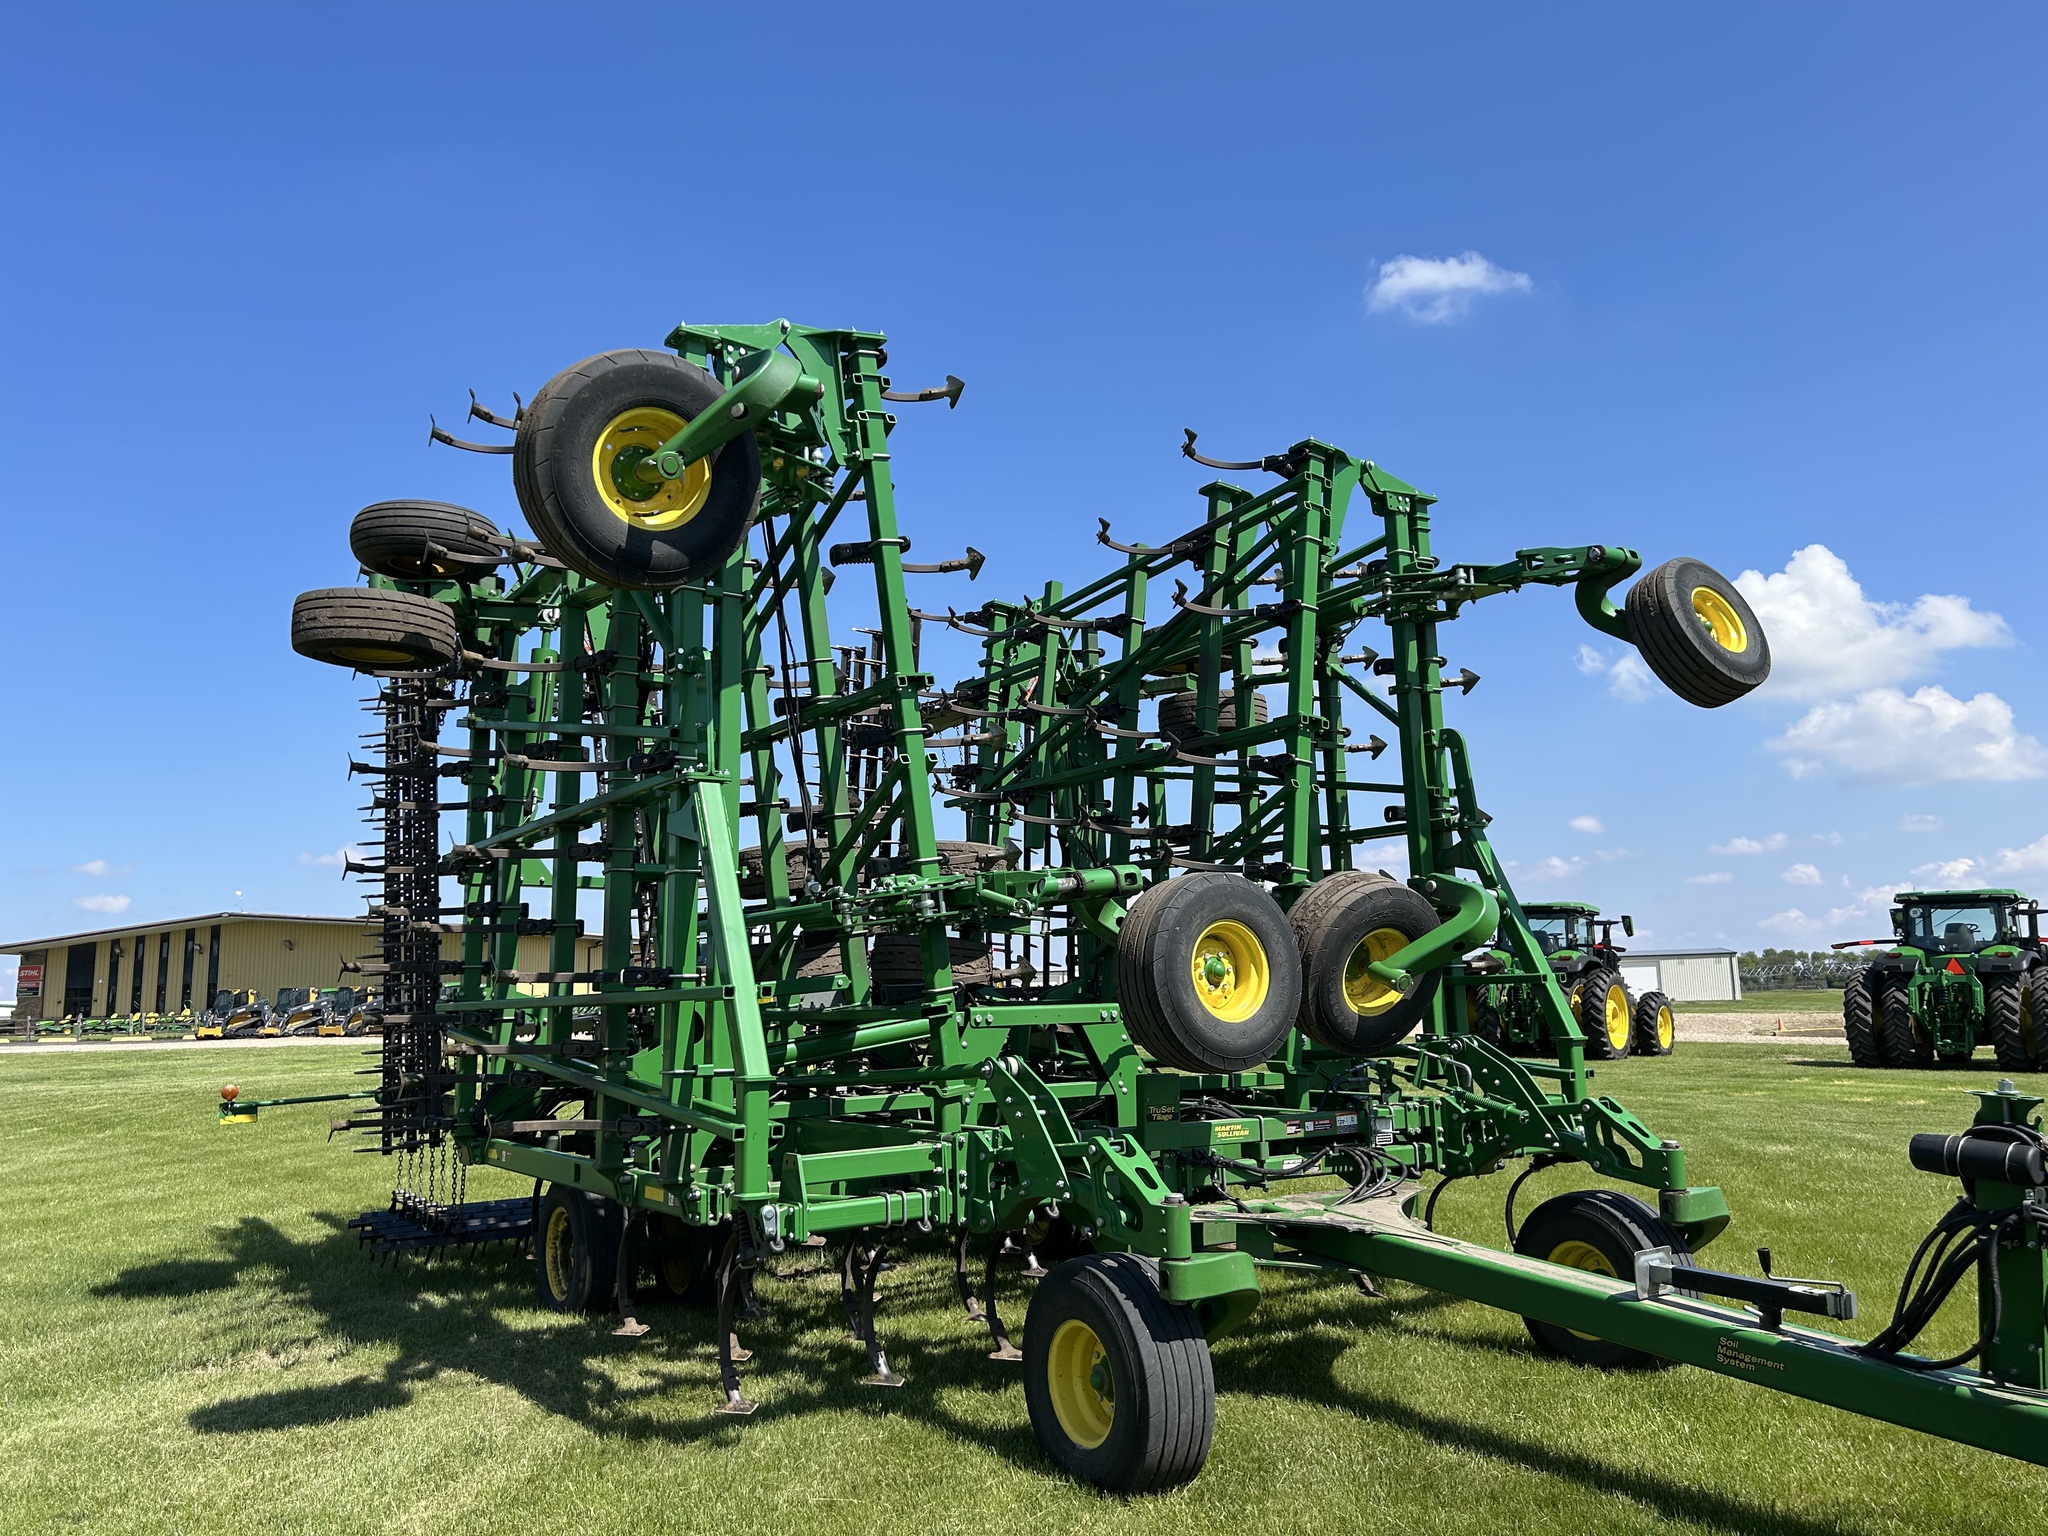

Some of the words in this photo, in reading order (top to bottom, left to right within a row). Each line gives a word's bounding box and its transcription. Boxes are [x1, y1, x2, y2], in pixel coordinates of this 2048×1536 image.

[1148, 1105, 1175, 1114] TruSet
[1151, 1113, 1173, 1121] Tillage
[1217, 1130, 1250, 1138] SULLIVAN
[1719, 1336, 1739, 1348] Soil
[1716, 1353, 1755, 1371] System
[1717, 1345, 1785, 1371] Management
